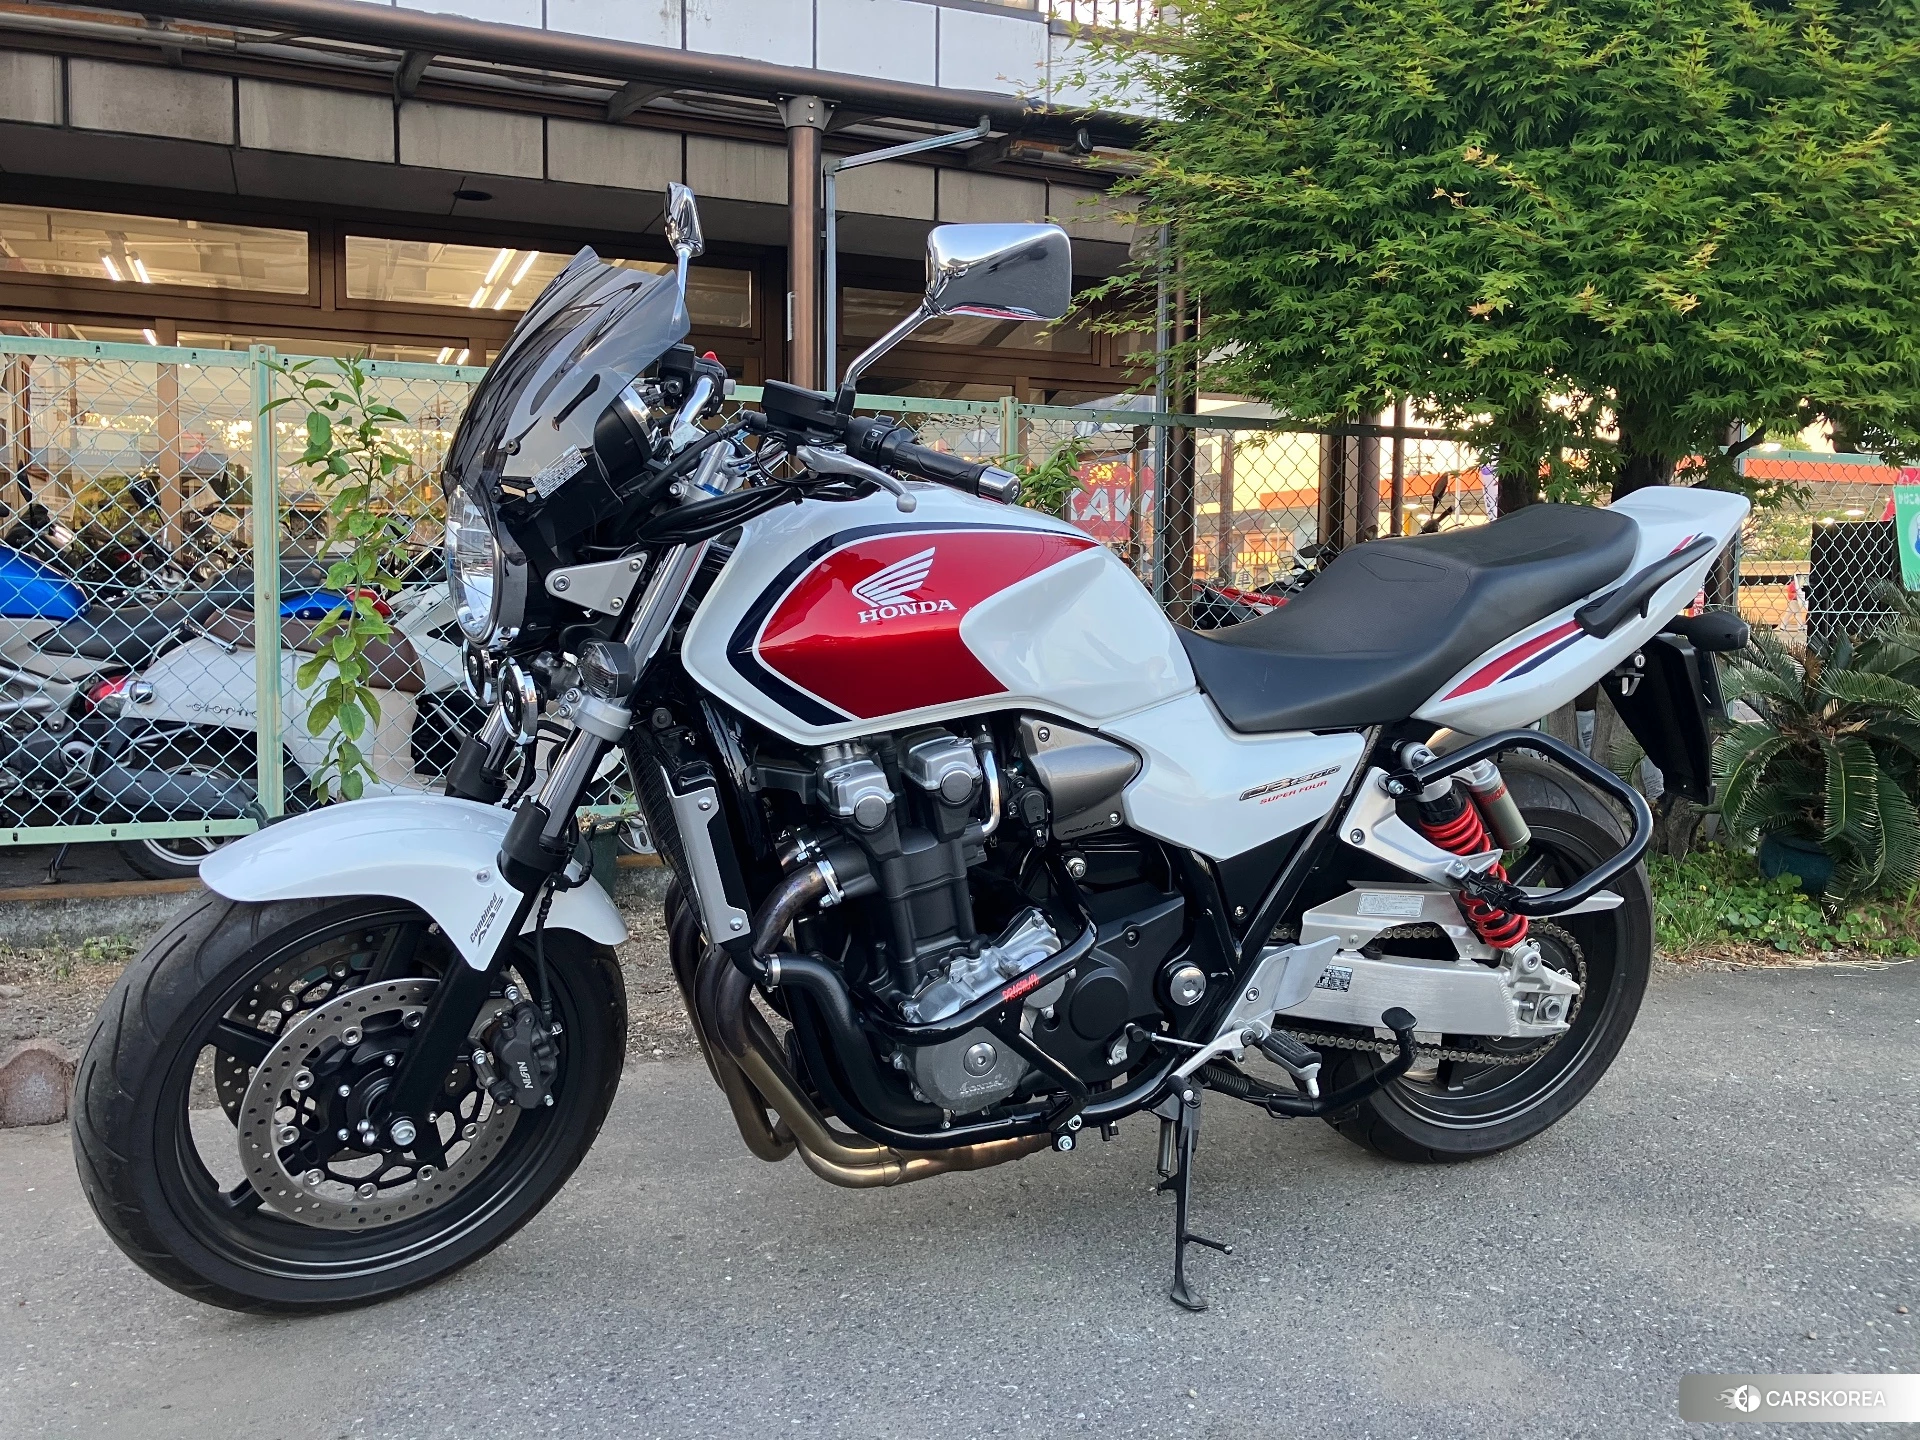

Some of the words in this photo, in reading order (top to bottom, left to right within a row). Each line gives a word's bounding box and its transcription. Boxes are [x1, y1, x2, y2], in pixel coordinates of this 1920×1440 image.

[857, 599, 957, 624] HONDA
[1260, 789, 1296, 804] SUPER
[1298, 780, 1328, 793] FOUR
[470, 892, 497, 943] Combined
[477, 895, 504, 947] ABS
[516, 1061, 534, 1089] NISSIN
